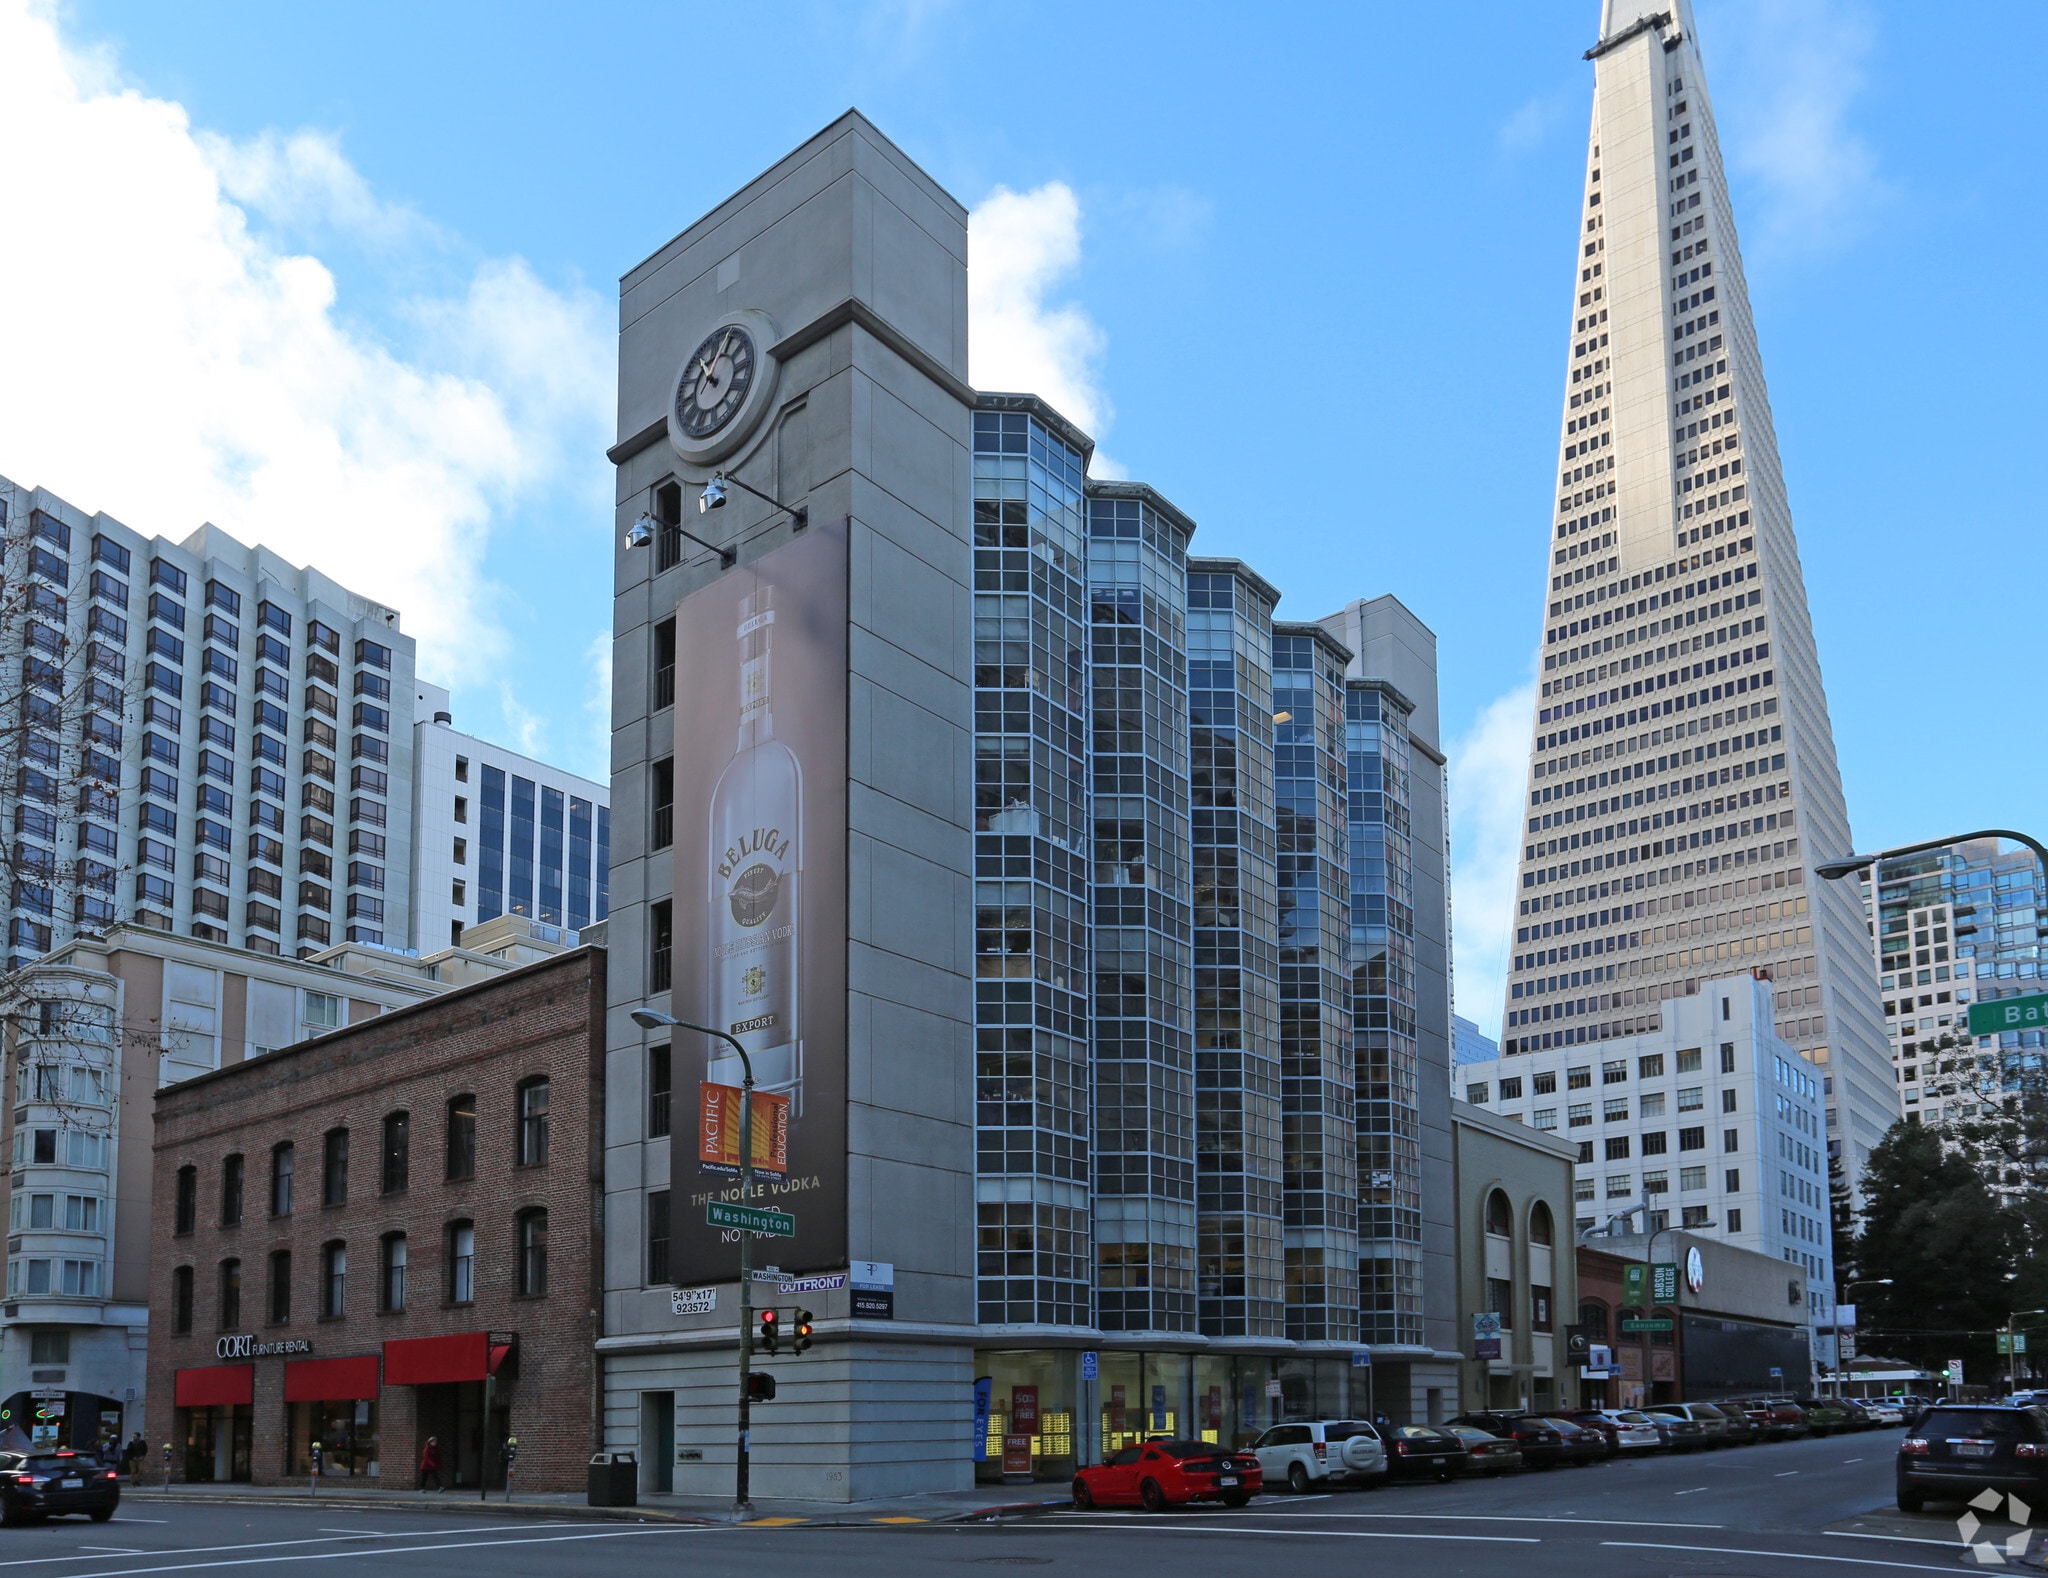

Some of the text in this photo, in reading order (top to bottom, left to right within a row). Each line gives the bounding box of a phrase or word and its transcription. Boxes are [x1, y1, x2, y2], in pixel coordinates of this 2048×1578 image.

[717, 828, 790, 880] BELUGA
[741, 911, 767, 925] QUALITY
[735, 1015, 774, 1033] EXPORT
[705, 1090, 720, 1154] PACIFIC
[770, 1102, 779, 1158] Professional
[777, 1103, 788, 1165] EDUCATION
[771, 1175, 821, 1195] VODKA
[712, 1207, 790, 1231] Washington
[752, 1271, 793, 1283] WASHINGTON
[779, 1275, 843, 1293] OUTFRONT
[1654, 1266, 1675, 1298] BABSON COLLEGE
[676, 1301, 710, 1314] 923572
[855, 1302, 889, 1310] 415.820.5297
[216, 1335, 310, 1359] CORT FURNITURE RENTAL
[976, 1391, 988, 1416] FOR
[1014, 1411, 1035, 1420] FREE
[974, 1418, 985, 1447] EYES
[1007, 1438, 1027, 1446] FREE
[824, 1471, 843, 1482] 1983
